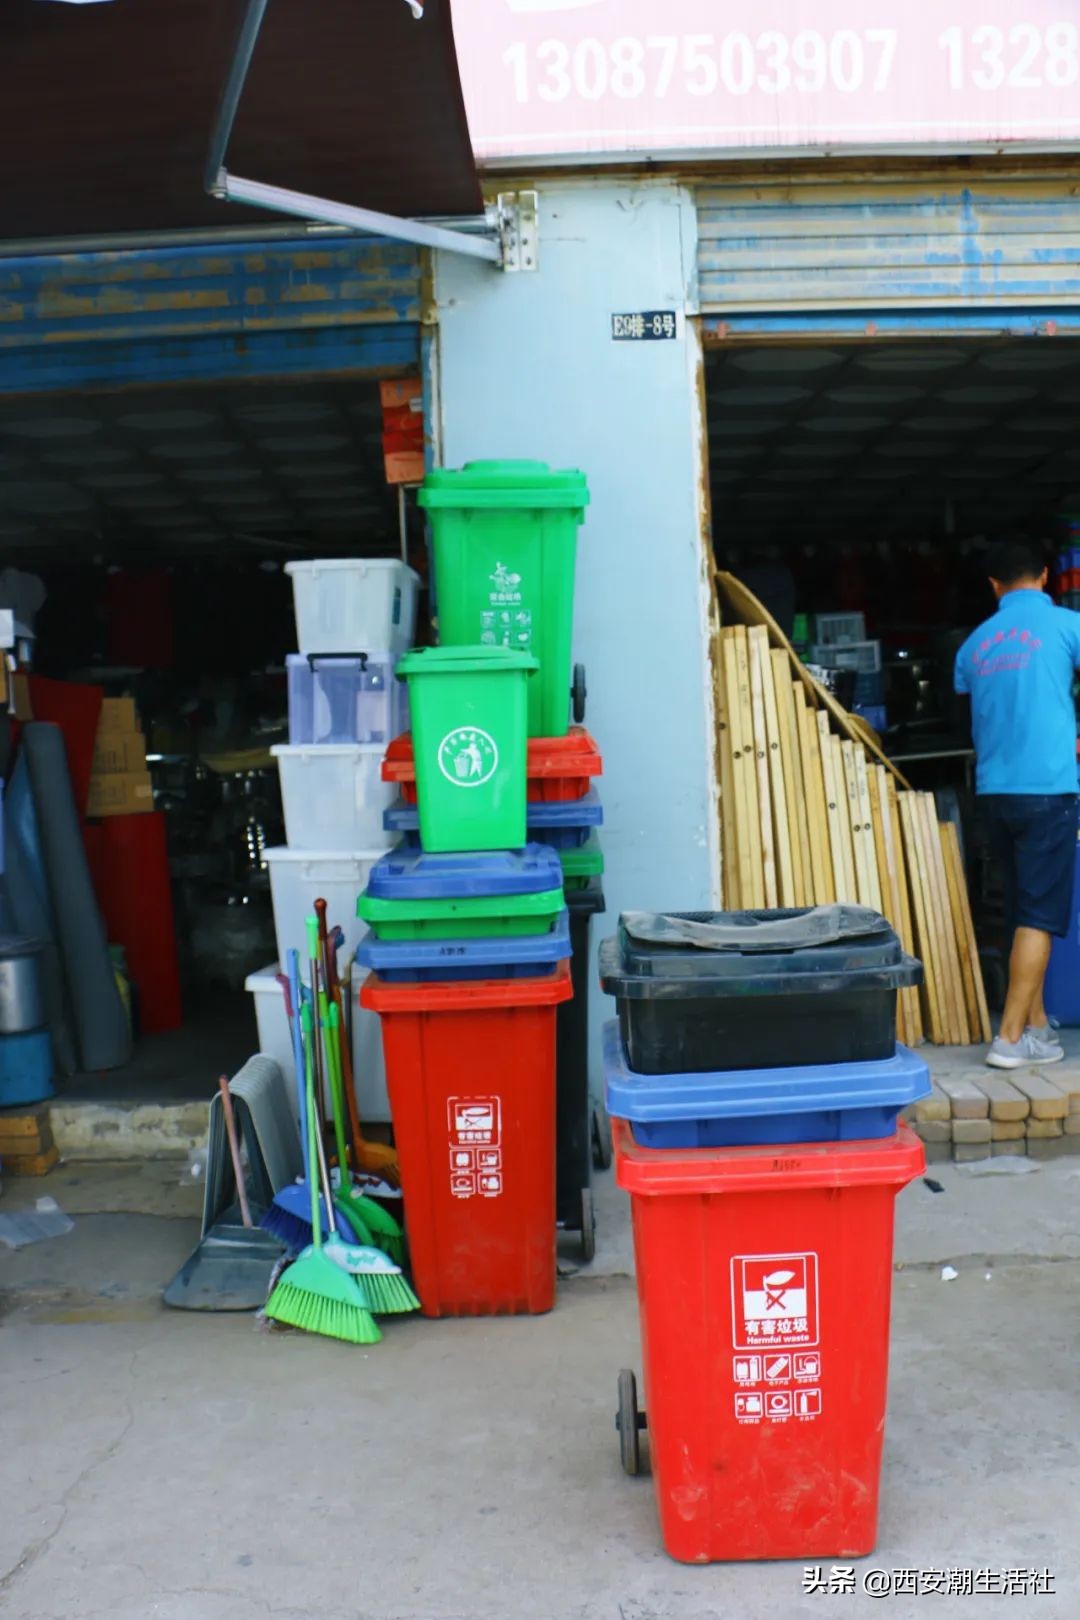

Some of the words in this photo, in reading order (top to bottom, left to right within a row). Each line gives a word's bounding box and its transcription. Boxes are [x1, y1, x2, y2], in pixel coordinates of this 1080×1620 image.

[503, 29, 896, 103] 13087503907
[745, 1318, 808, 1335] 有害垃圾
[746, 1335, 781, 1344] Harmful
[783, 1334, 809, 1343] waste
